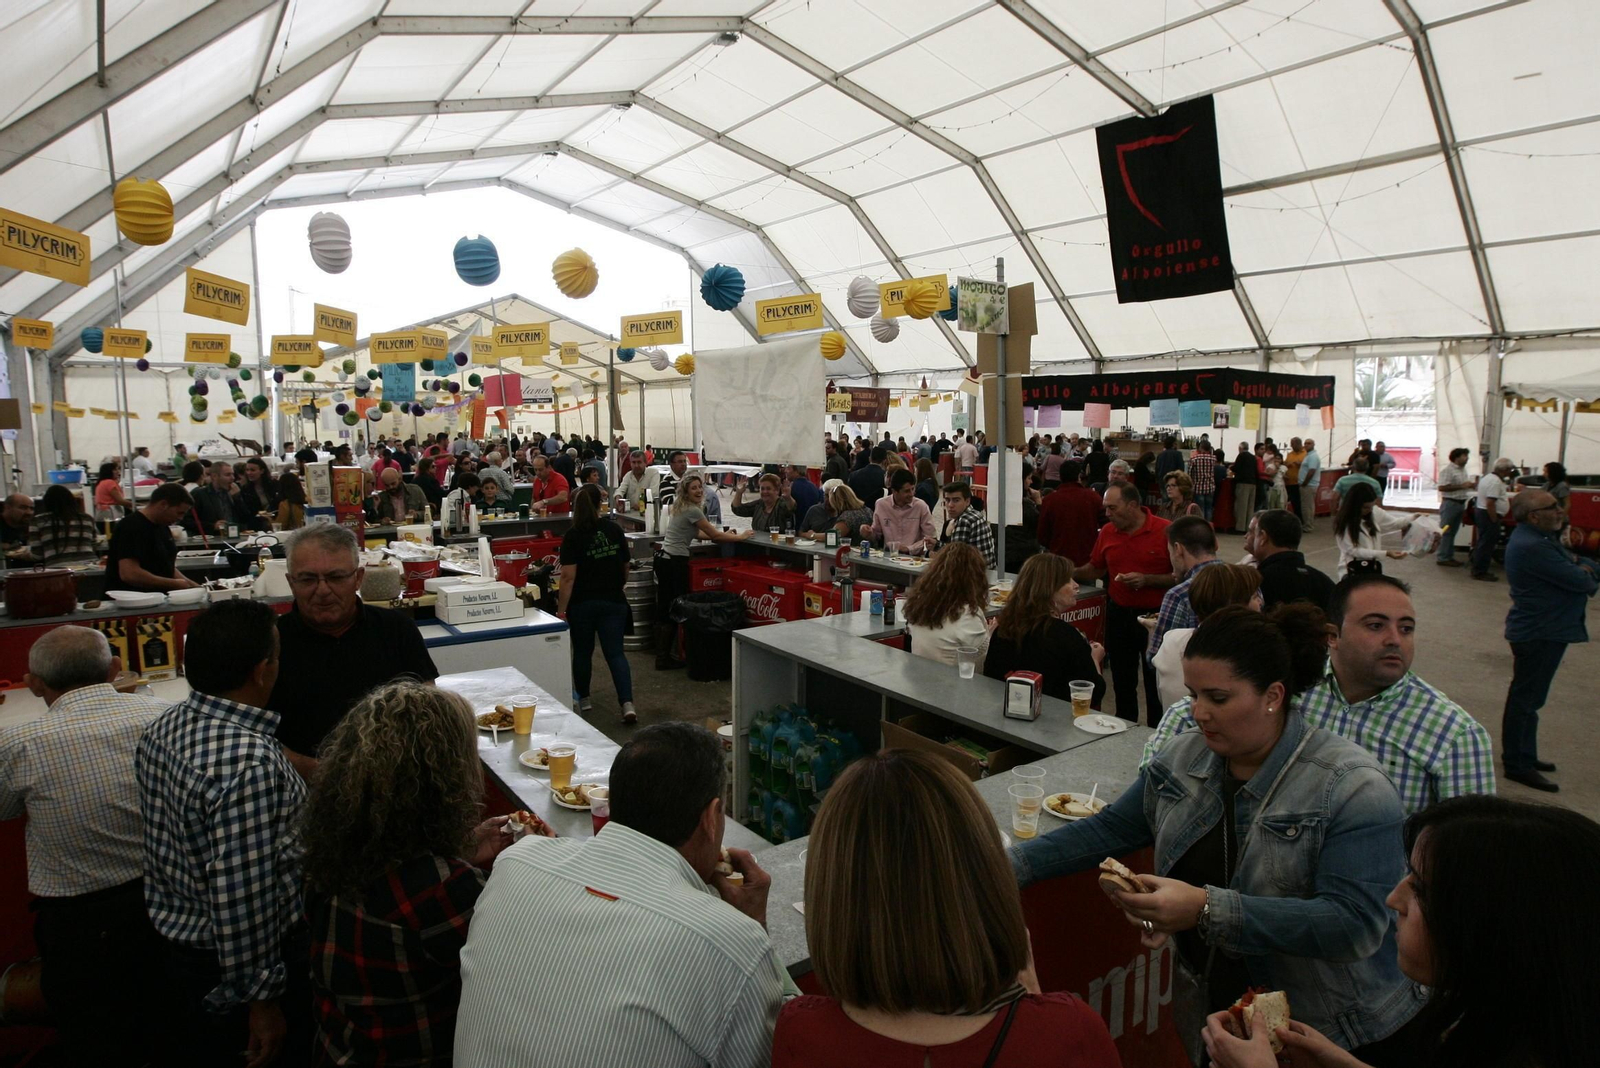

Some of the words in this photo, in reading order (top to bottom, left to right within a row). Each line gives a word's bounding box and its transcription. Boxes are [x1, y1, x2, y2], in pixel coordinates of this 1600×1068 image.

[8, 226, 76, 260] PILYCRIM
[1132, 239, 1202, 258] Orgullo
[196, 282, 241, 305] PILYCRIM
[766, 303, 812, 318] PILYCRIM
[320, 314, 352, 331] PILYCRIM
[630, 320, 673, 333] PILYCRIM
[19, 325, 47, 337] PILYCRIM
[500, 332, 541, 344] PILYCRIM
[110, 335, 140, 346] PILYCRIM
[192, 340, 224, 350] PILYCRIM
[277, 342, 312, 352] PILYCRIM
[377, 339, 414, 350] PILYCRIM
[1090, 382, 1189, 399] Albojense
[1233, 380, 1272, 399] Orgullo
[1060, 606, 1100, 622] ruzcampo
